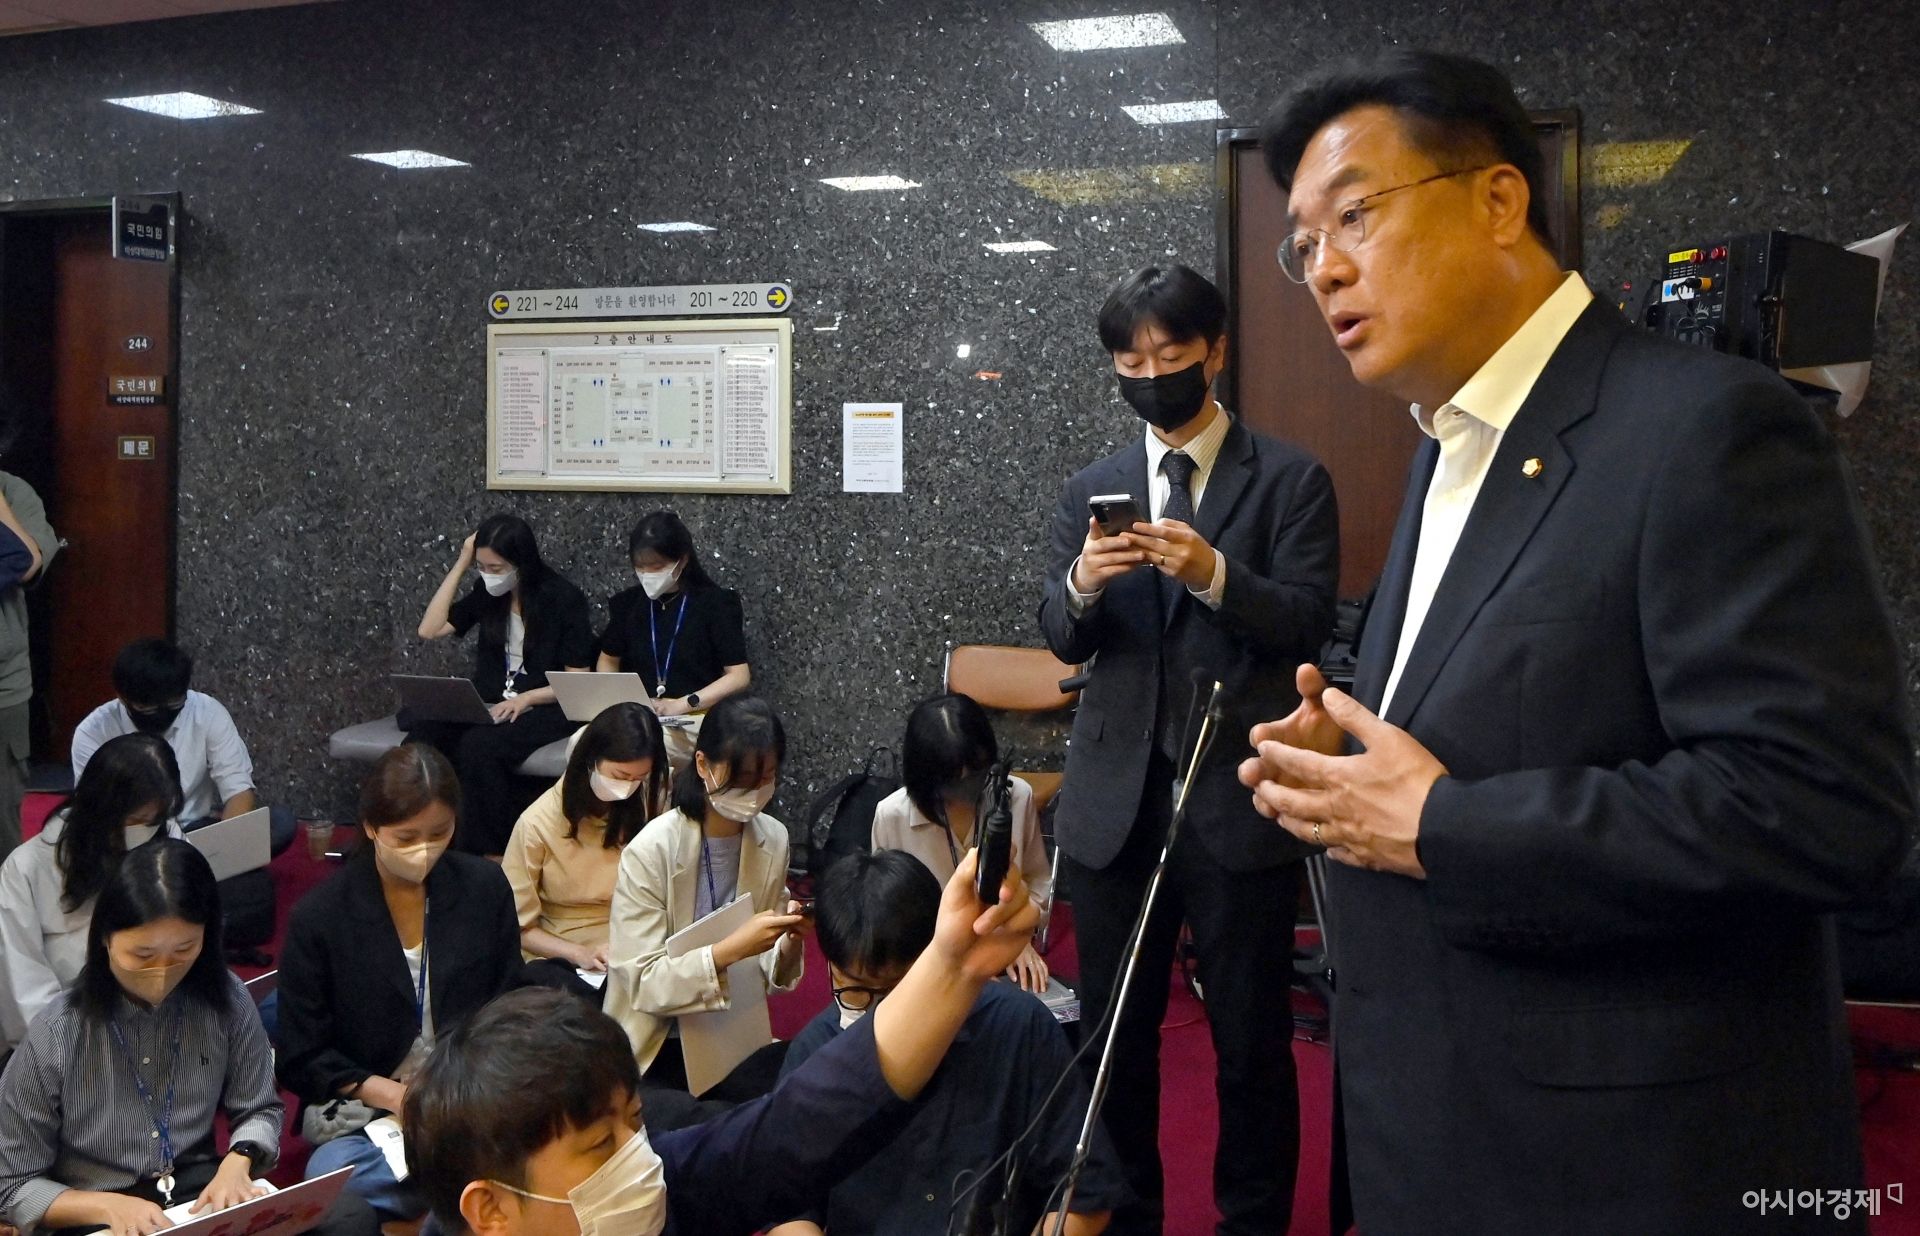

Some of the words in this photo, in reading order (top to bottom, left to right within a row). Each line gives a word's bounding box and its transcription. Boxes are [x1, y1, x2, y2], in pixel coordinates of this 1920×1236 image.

[516, 296, 538, 311] 221
[555, 295, 579, 311] 244
[628, 293, 676, 308] 환영합니다
[690, 291, 712, 307] 201
[732, 290, 758, 307] 220
[128, 338, 148, 350] 244
[116, 379, 157, 392] 국민의힘
